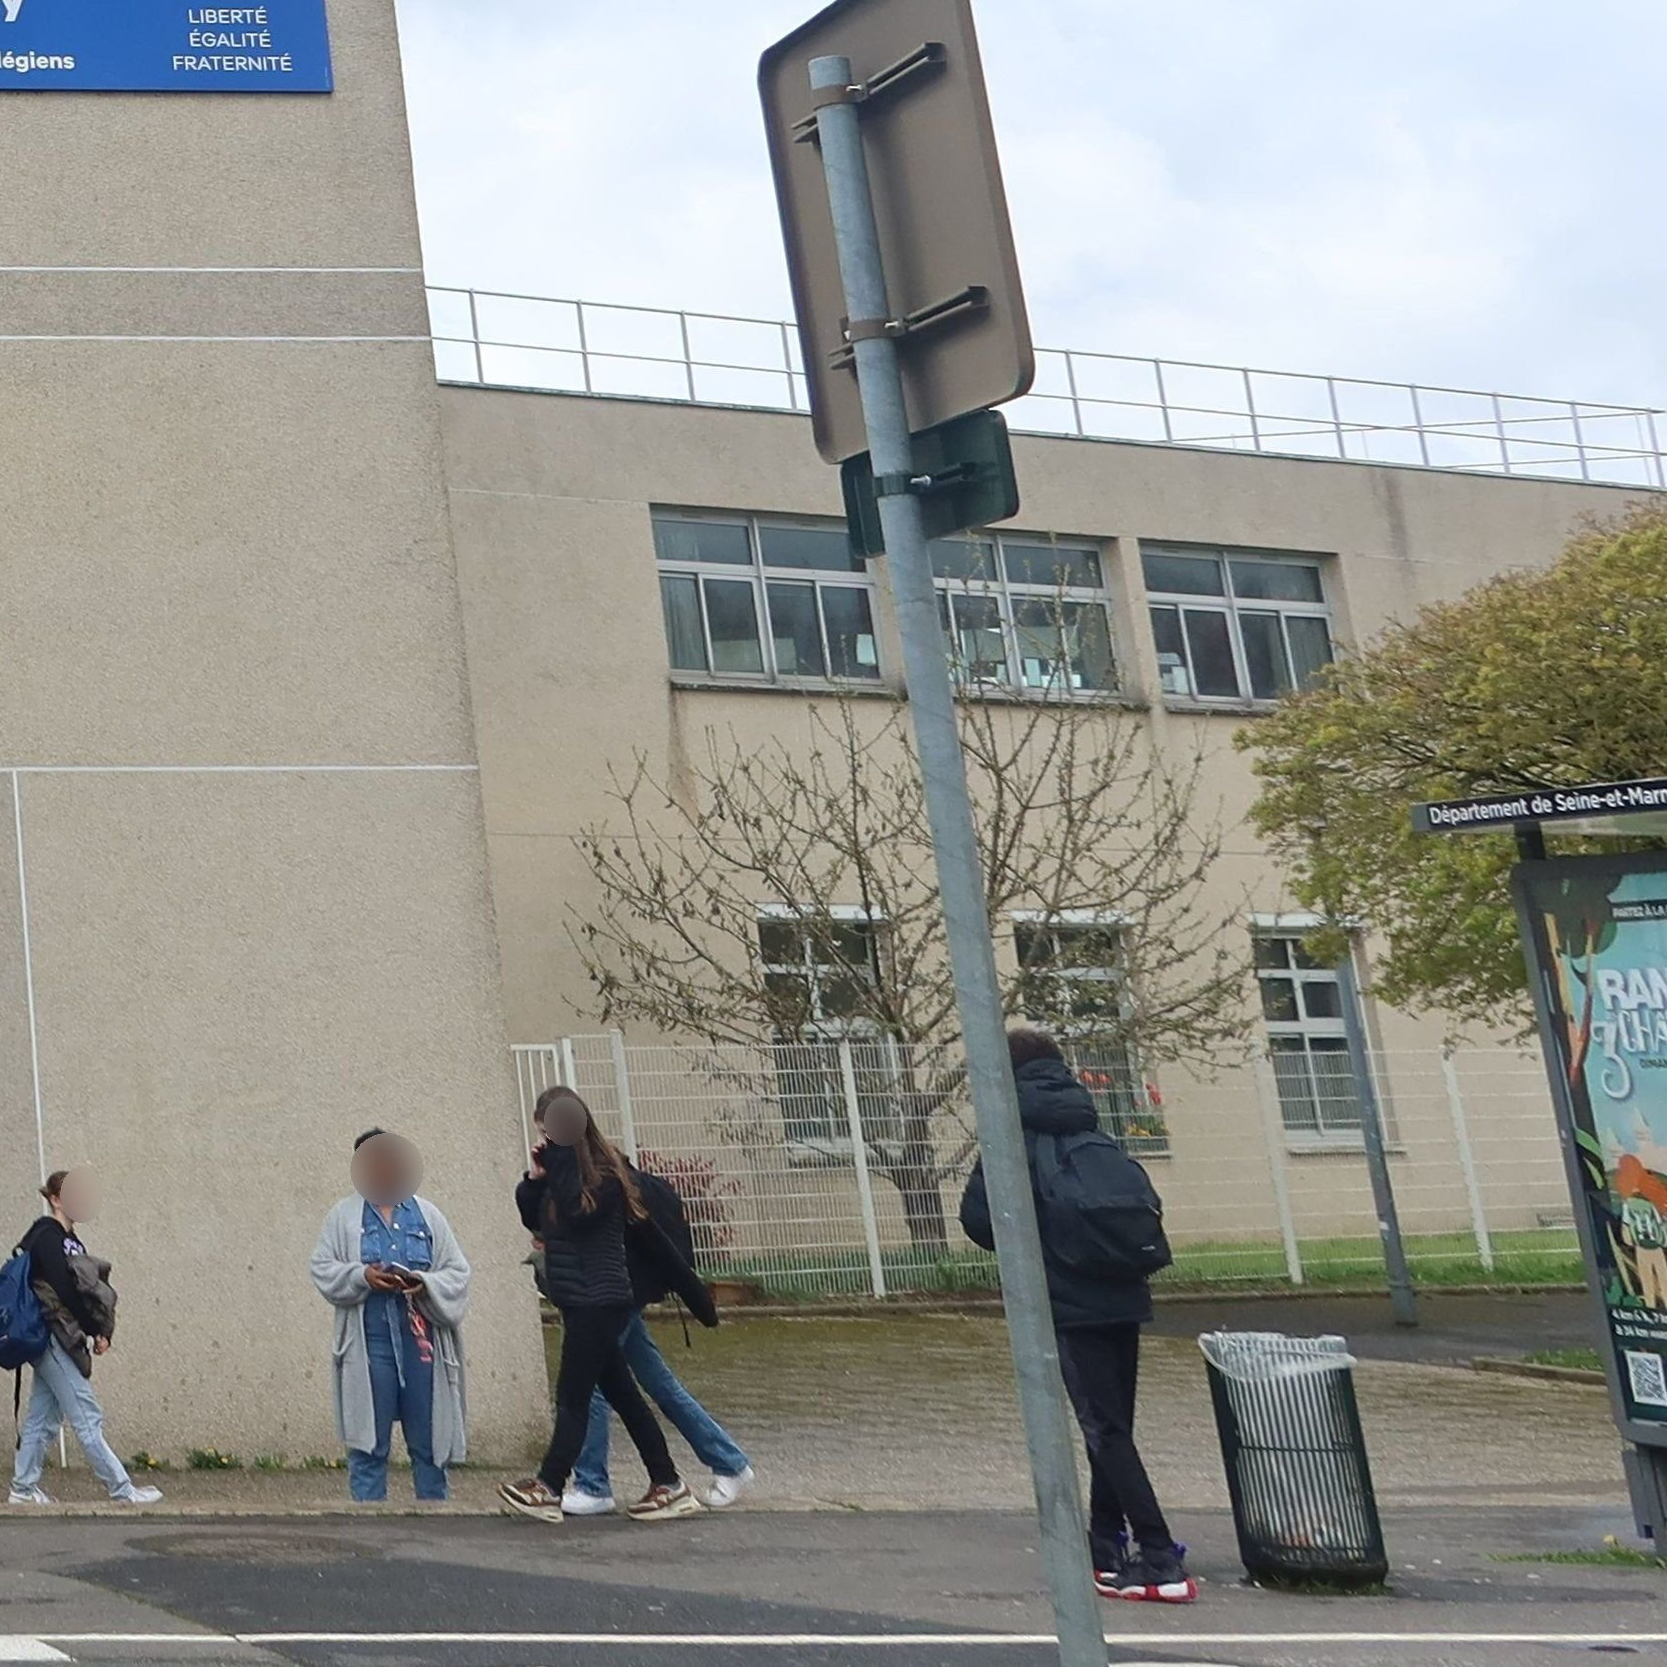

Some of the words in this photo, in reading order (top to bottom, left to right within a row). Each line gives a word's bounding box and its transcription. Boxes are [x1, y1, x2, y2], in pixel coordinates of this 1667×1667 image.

[187, 5, 268, 25] LIBERTÉ
[188, 28, 272, 48] ÉGALITÉ
[172, 52, 294, 72] FRATERNITÉ
[1428, 798, 1530, 826] Département
[1531, 794, 1554, 814] de
